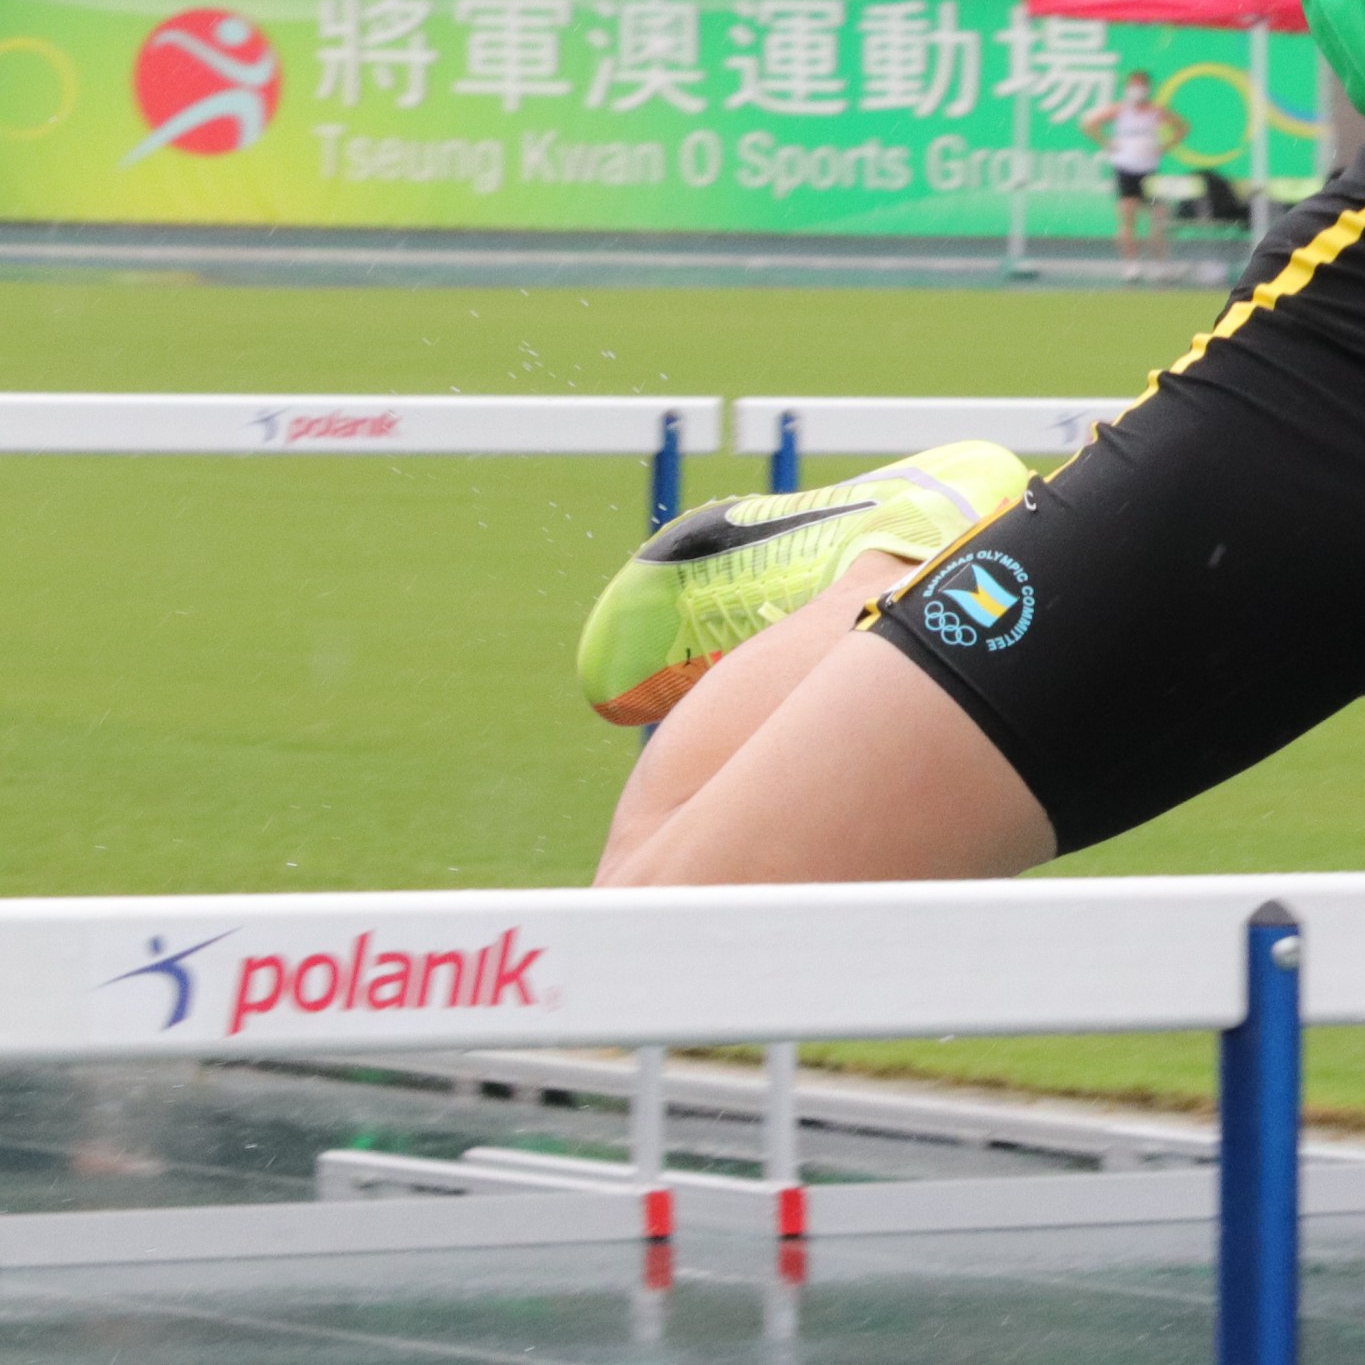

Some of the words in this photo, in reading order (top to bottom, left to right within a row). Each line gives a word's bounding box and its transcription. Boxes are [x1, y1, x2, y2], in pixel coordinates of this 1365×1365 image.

[312, 123, 506, 194] Tseung
[518, 128, 669, 187] Kwan
[679, 128, 723, 189] O
[736, 131, 914, 198] Sports
[284, 408, 402, 446] polanik
[922, 553, 975, 598] BAHAMAS
[976, 549, 1030, 584] OLYMPIC
[985, 584, 1036, 652] COMMITTEE
[225, 924, 549, 1037] polanik
